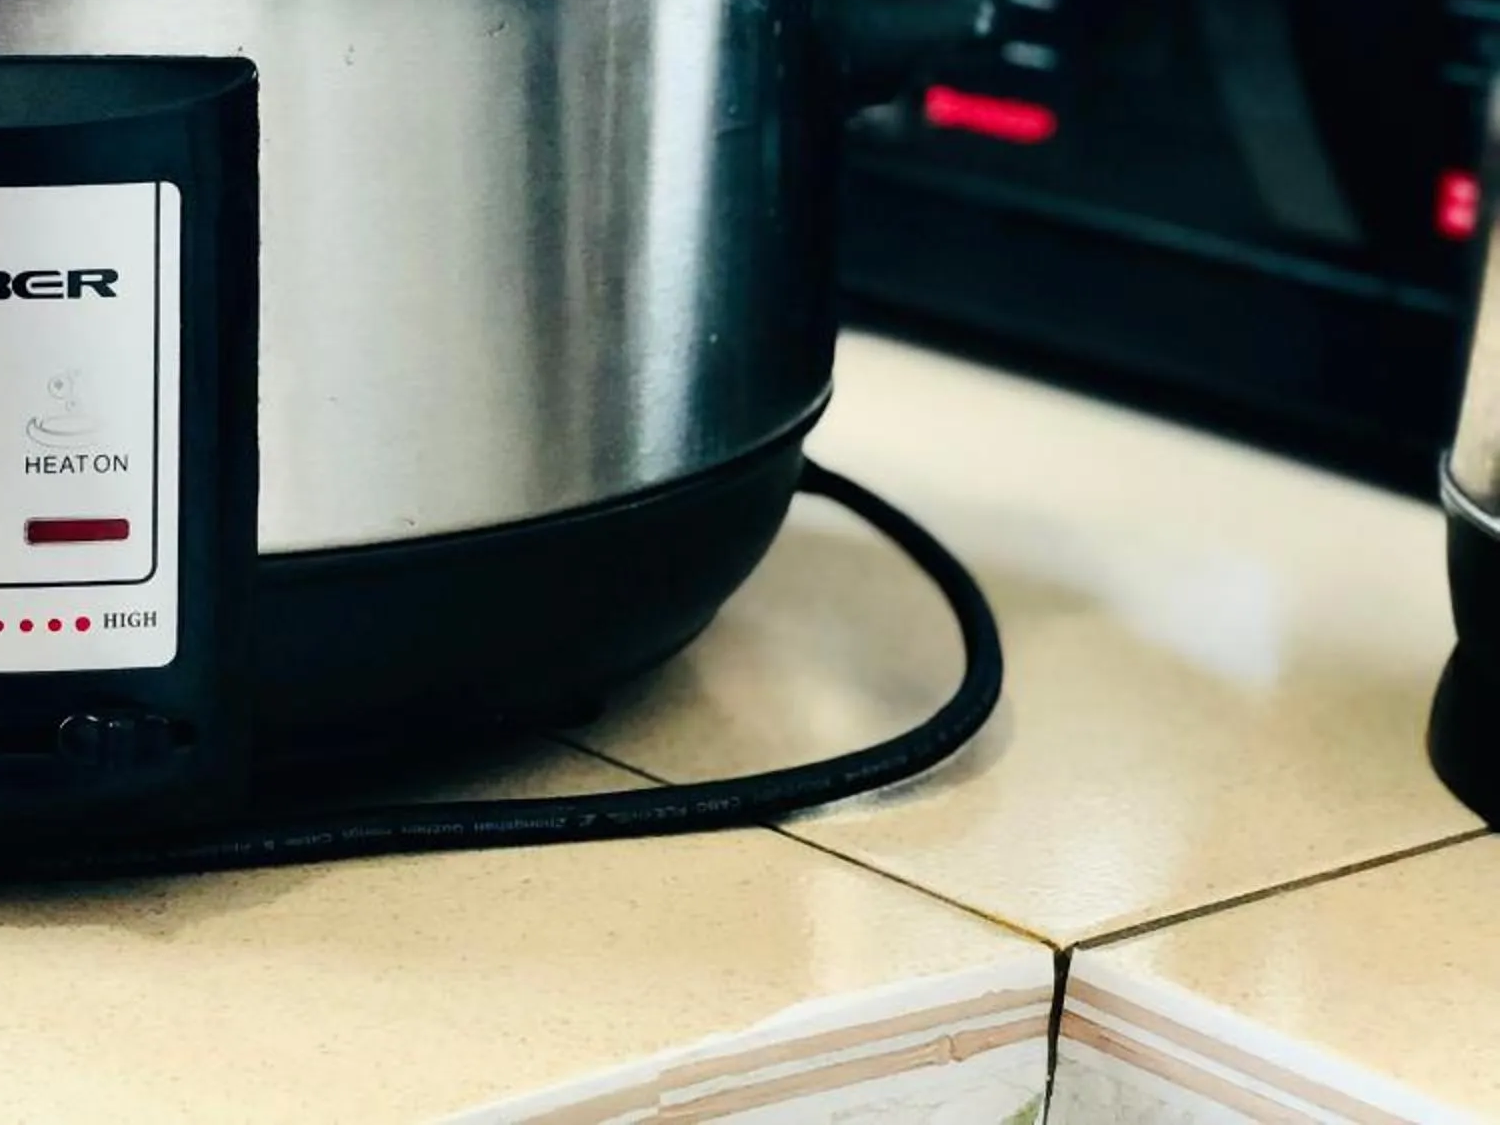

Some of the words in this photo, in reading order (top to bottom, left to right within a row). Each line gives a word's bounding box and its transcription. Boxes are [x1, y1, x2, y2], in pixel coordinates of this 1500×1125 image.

[25, 455, 88, 475] HEAT
[93, 454, 128, 473] ON
[102, 611, 157, 630] HIGH
